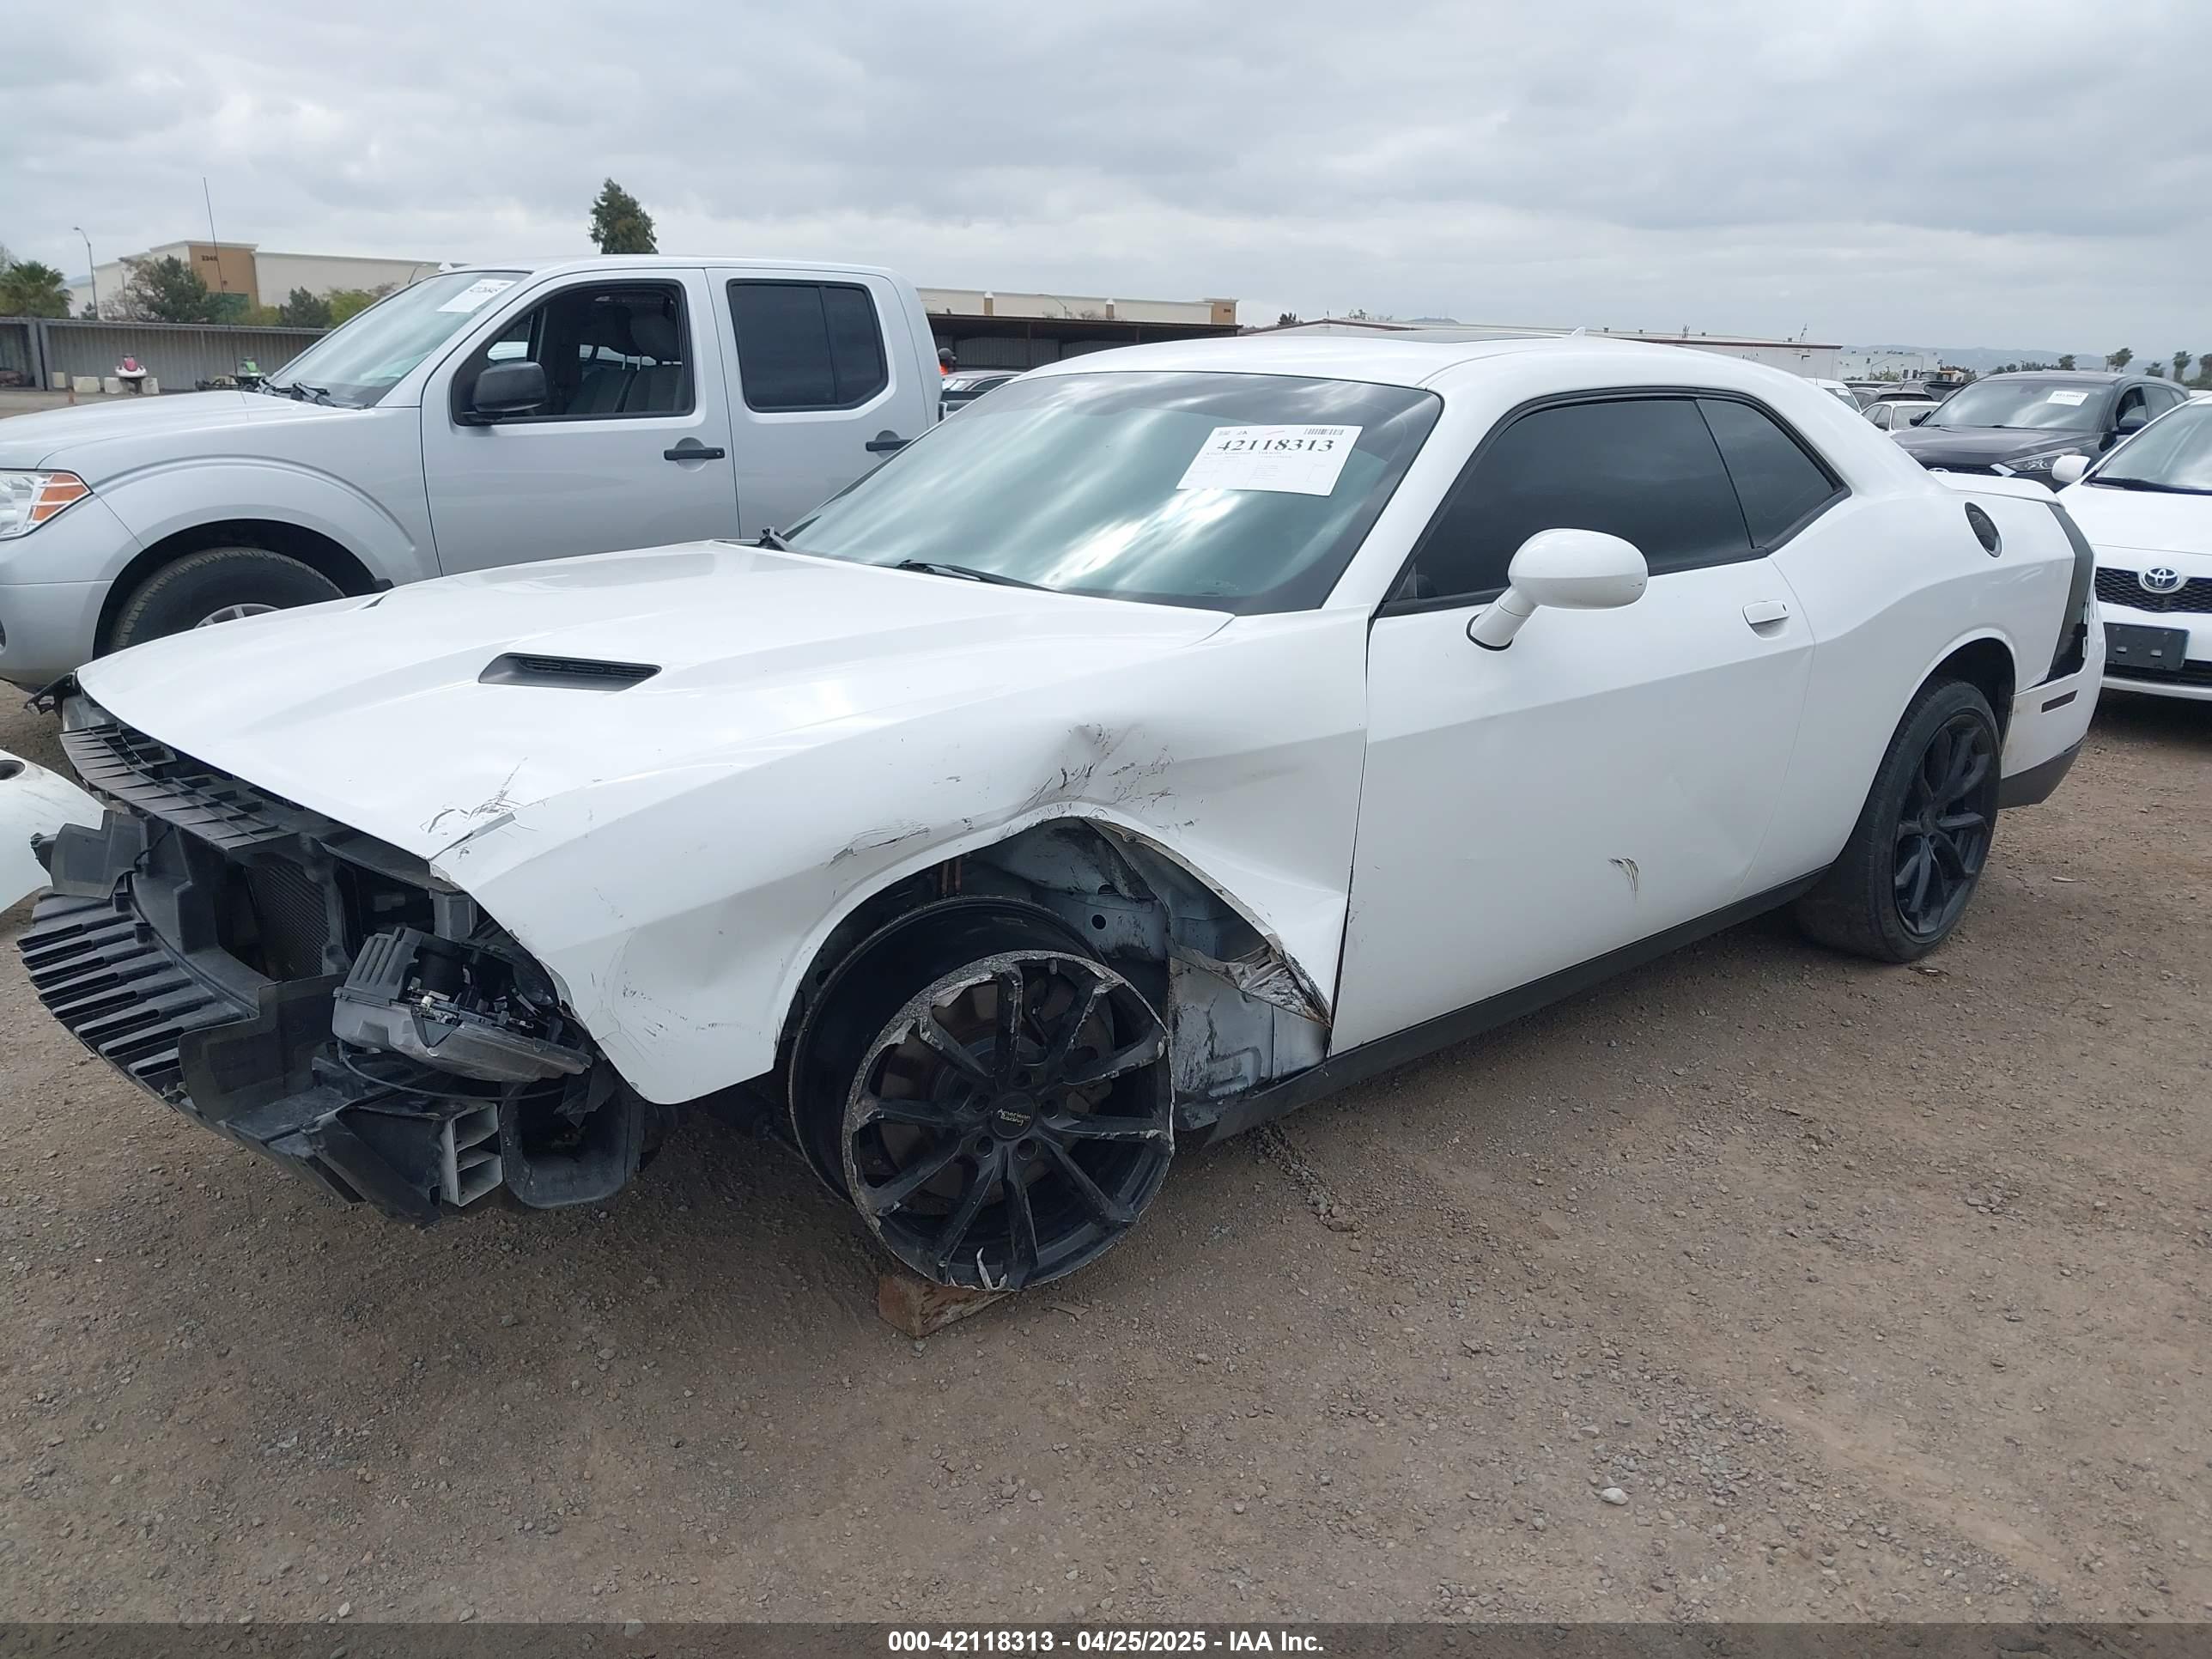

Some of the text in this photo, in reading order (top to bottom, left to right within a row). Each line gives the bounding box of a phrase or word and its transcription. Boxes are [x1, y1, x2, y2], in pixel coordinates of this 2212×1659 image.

[1216, 439, 1334, 452] 42118313
[997, 1108, 1031, 1120] American
[1000, 1114, 1024, 1127] Racing
